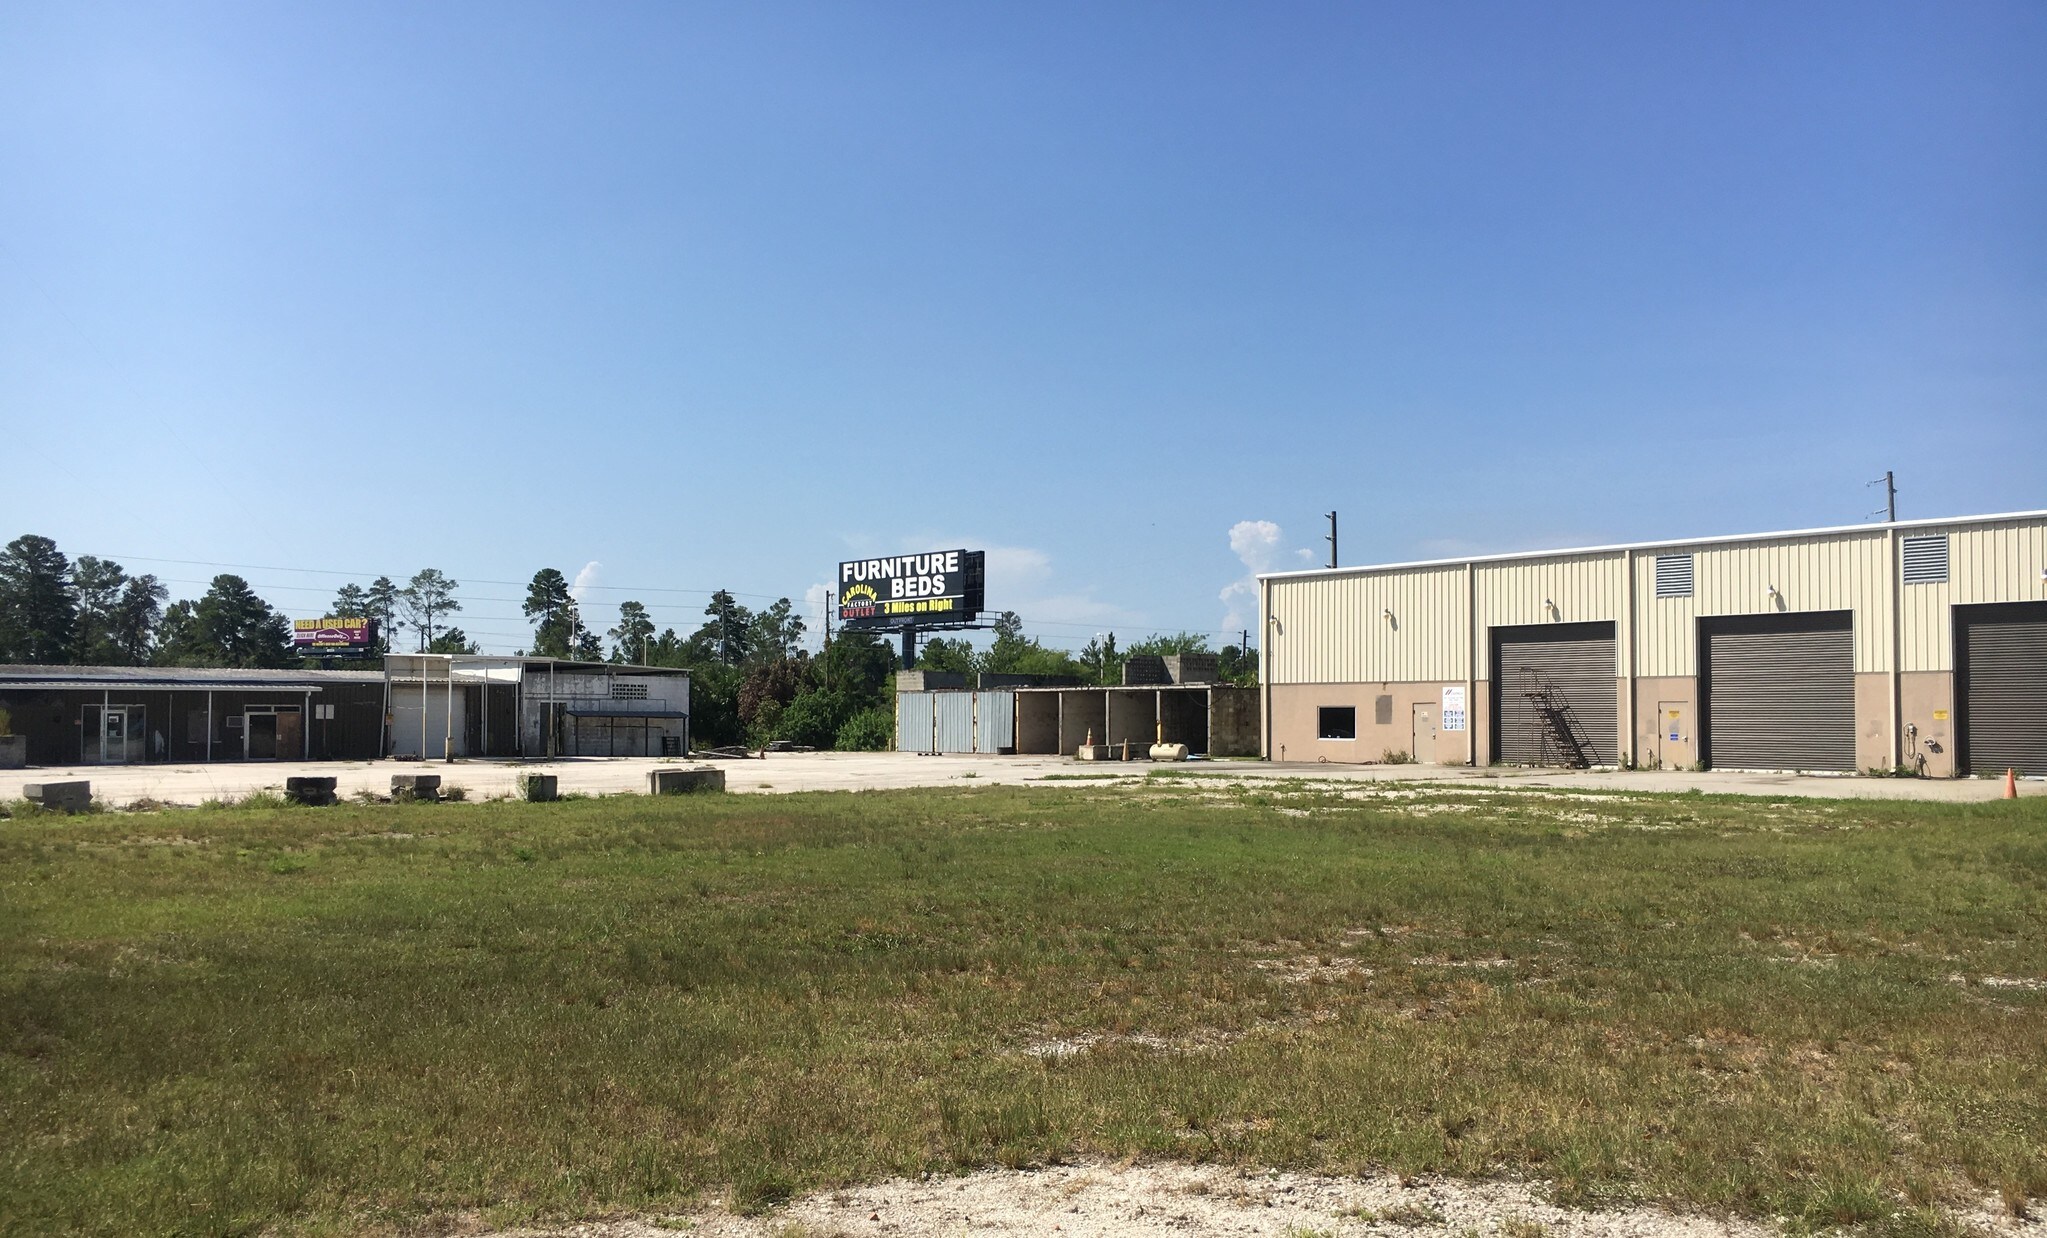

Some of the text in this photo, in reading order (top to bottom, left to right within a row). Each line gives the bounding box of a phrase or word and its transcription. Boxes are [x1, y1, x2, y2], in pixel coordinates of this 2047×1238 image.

[843, 552, 959, 582] FURNITURE
[891, 575, 946, 598] BEDS
[842, 584, 877, 605] CAROLINA
[847, 600, 873, 608] FACTORY
[884, 599, 953, 614] 3 Miles on Right
[843, 608, 876, 617] OUTLET
[295, 618, 368, 630] NEED A USED CAR?
